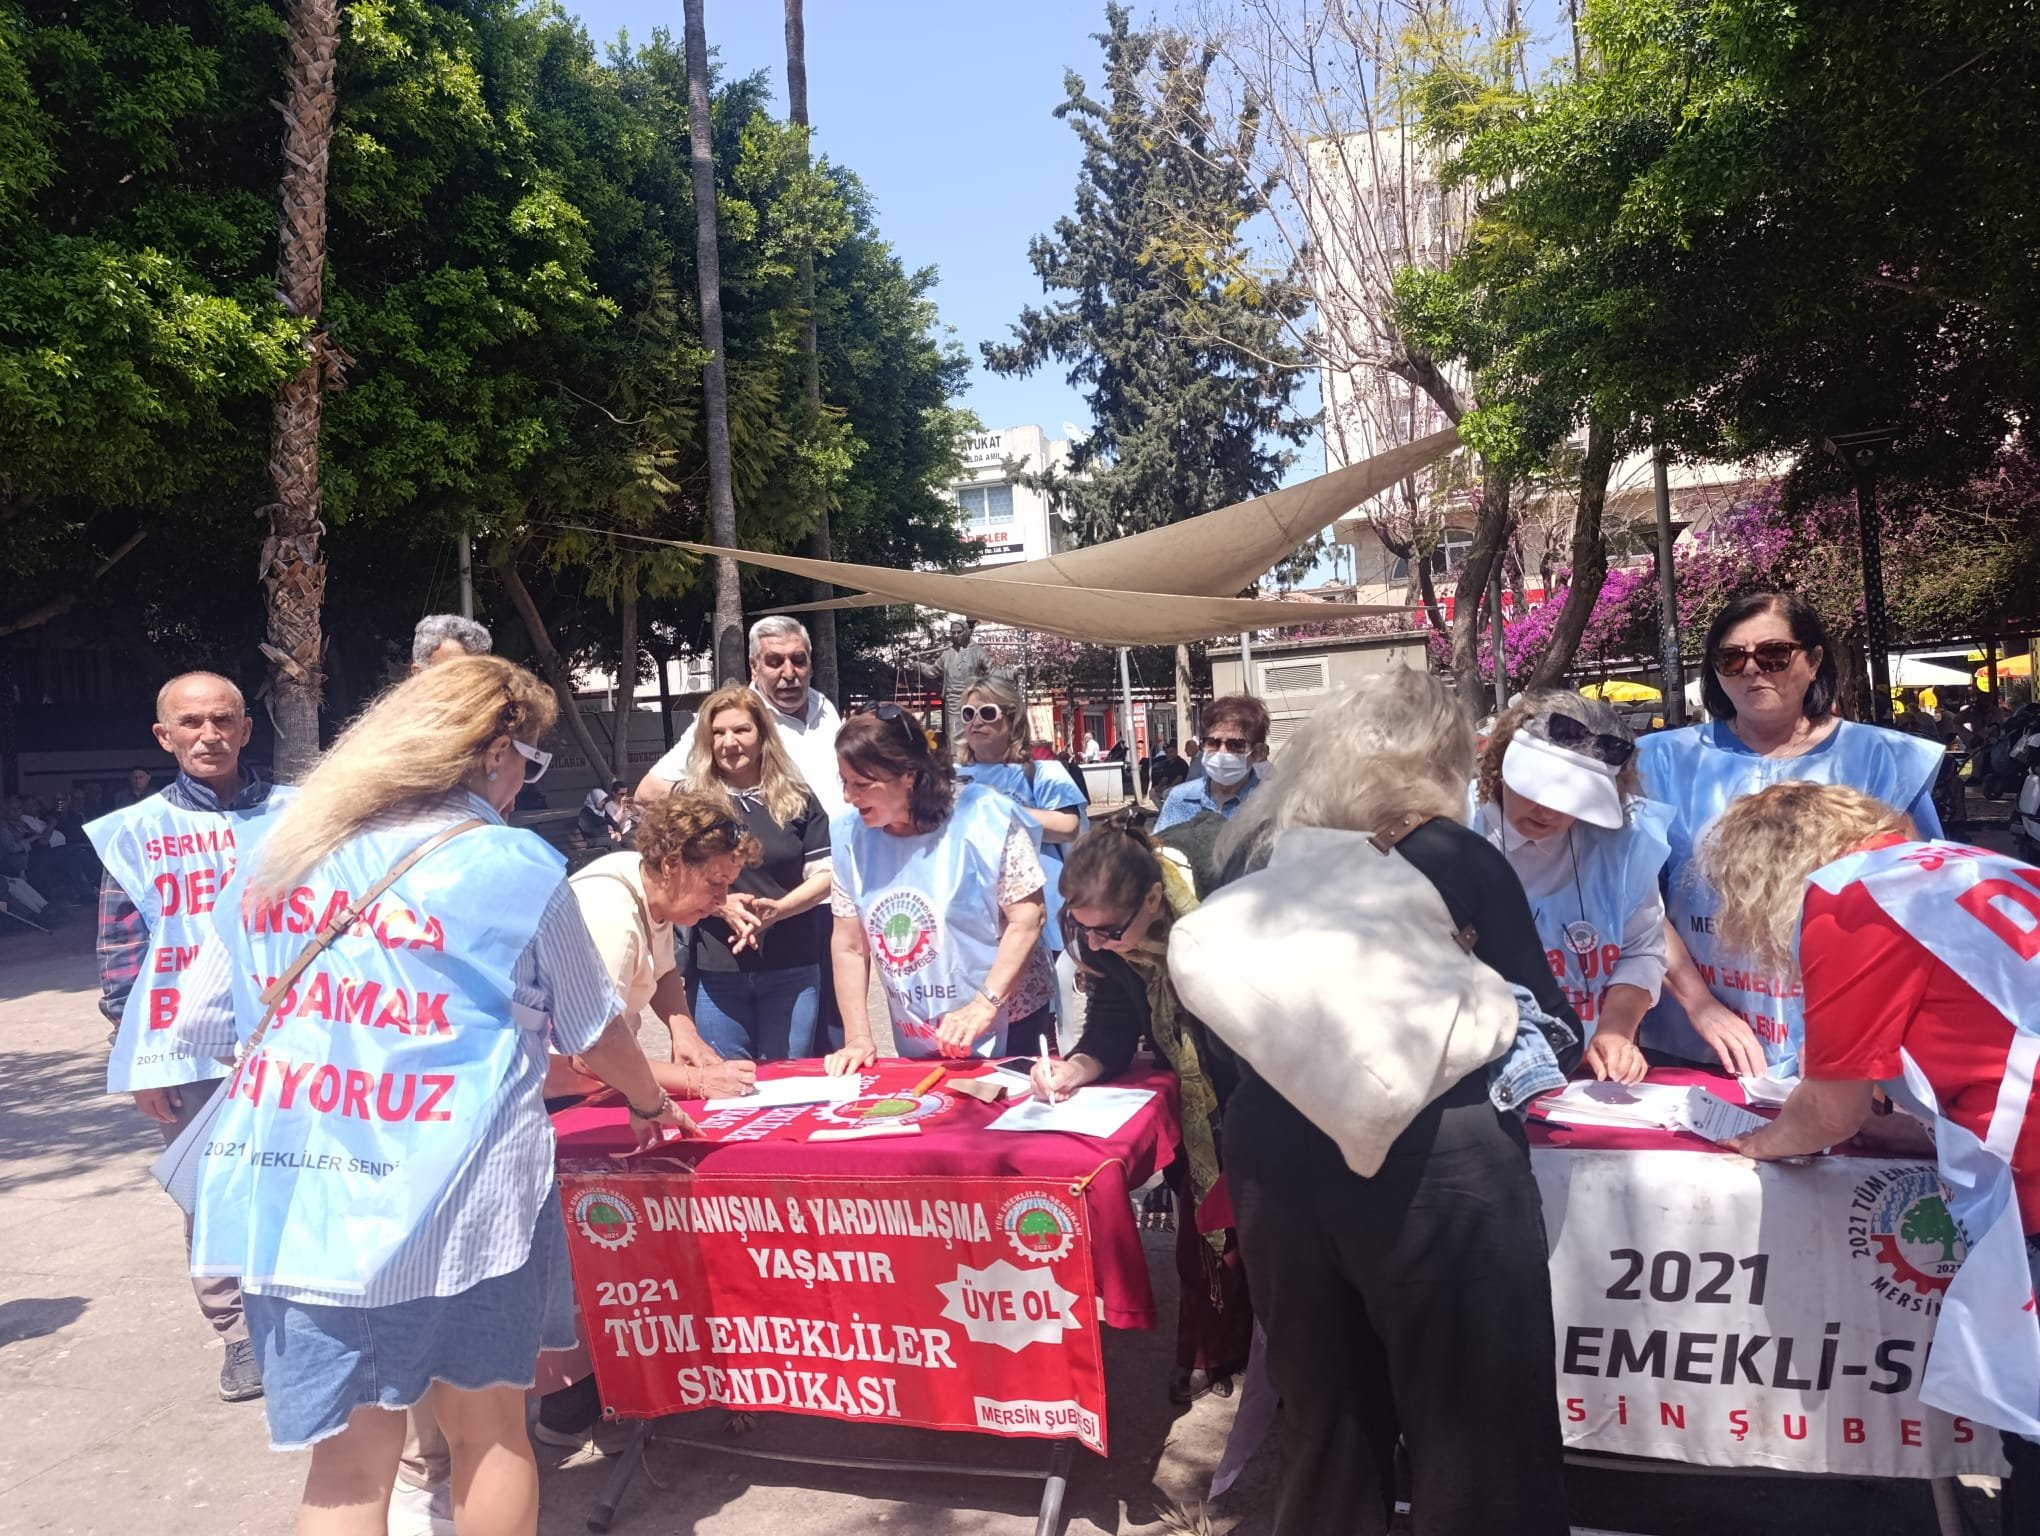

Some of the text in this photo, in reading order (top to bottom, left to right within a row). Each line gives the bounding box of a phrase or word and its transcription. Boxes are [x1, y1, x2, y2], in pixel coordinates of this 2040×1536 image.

[961, 436, 1001, 453] AVUKAT
[153, 856, 236, 917] DE
[136, 1053, 165, 1067] 2021
[204, 1141, 247, 1158] 2021
[1853, 1175, 1885, 1212] TÜM
[643, 1196, 992, 1249] DAYANIŞMA & YARDIMLAŞMA
[1848, 1214, 1872, 1259] 2021
[747, 1248, 896, 1289] YAŞATIR
[1606, 1248, 1769, 1305] 2021
[596, 1279, 679, 1306] 2021
[962, 1279, 1061, 1322] ÜYE OL
[604, 1307, 957, 1369] TÜM EMEKLİLER
[1562, 1322, 1930, 1395] EMEKLİ-S
[677, 1361, 902, 1417] SENDİKASI
[981, 1404, 1097, 1438] MERSİN ŞUBESİ
